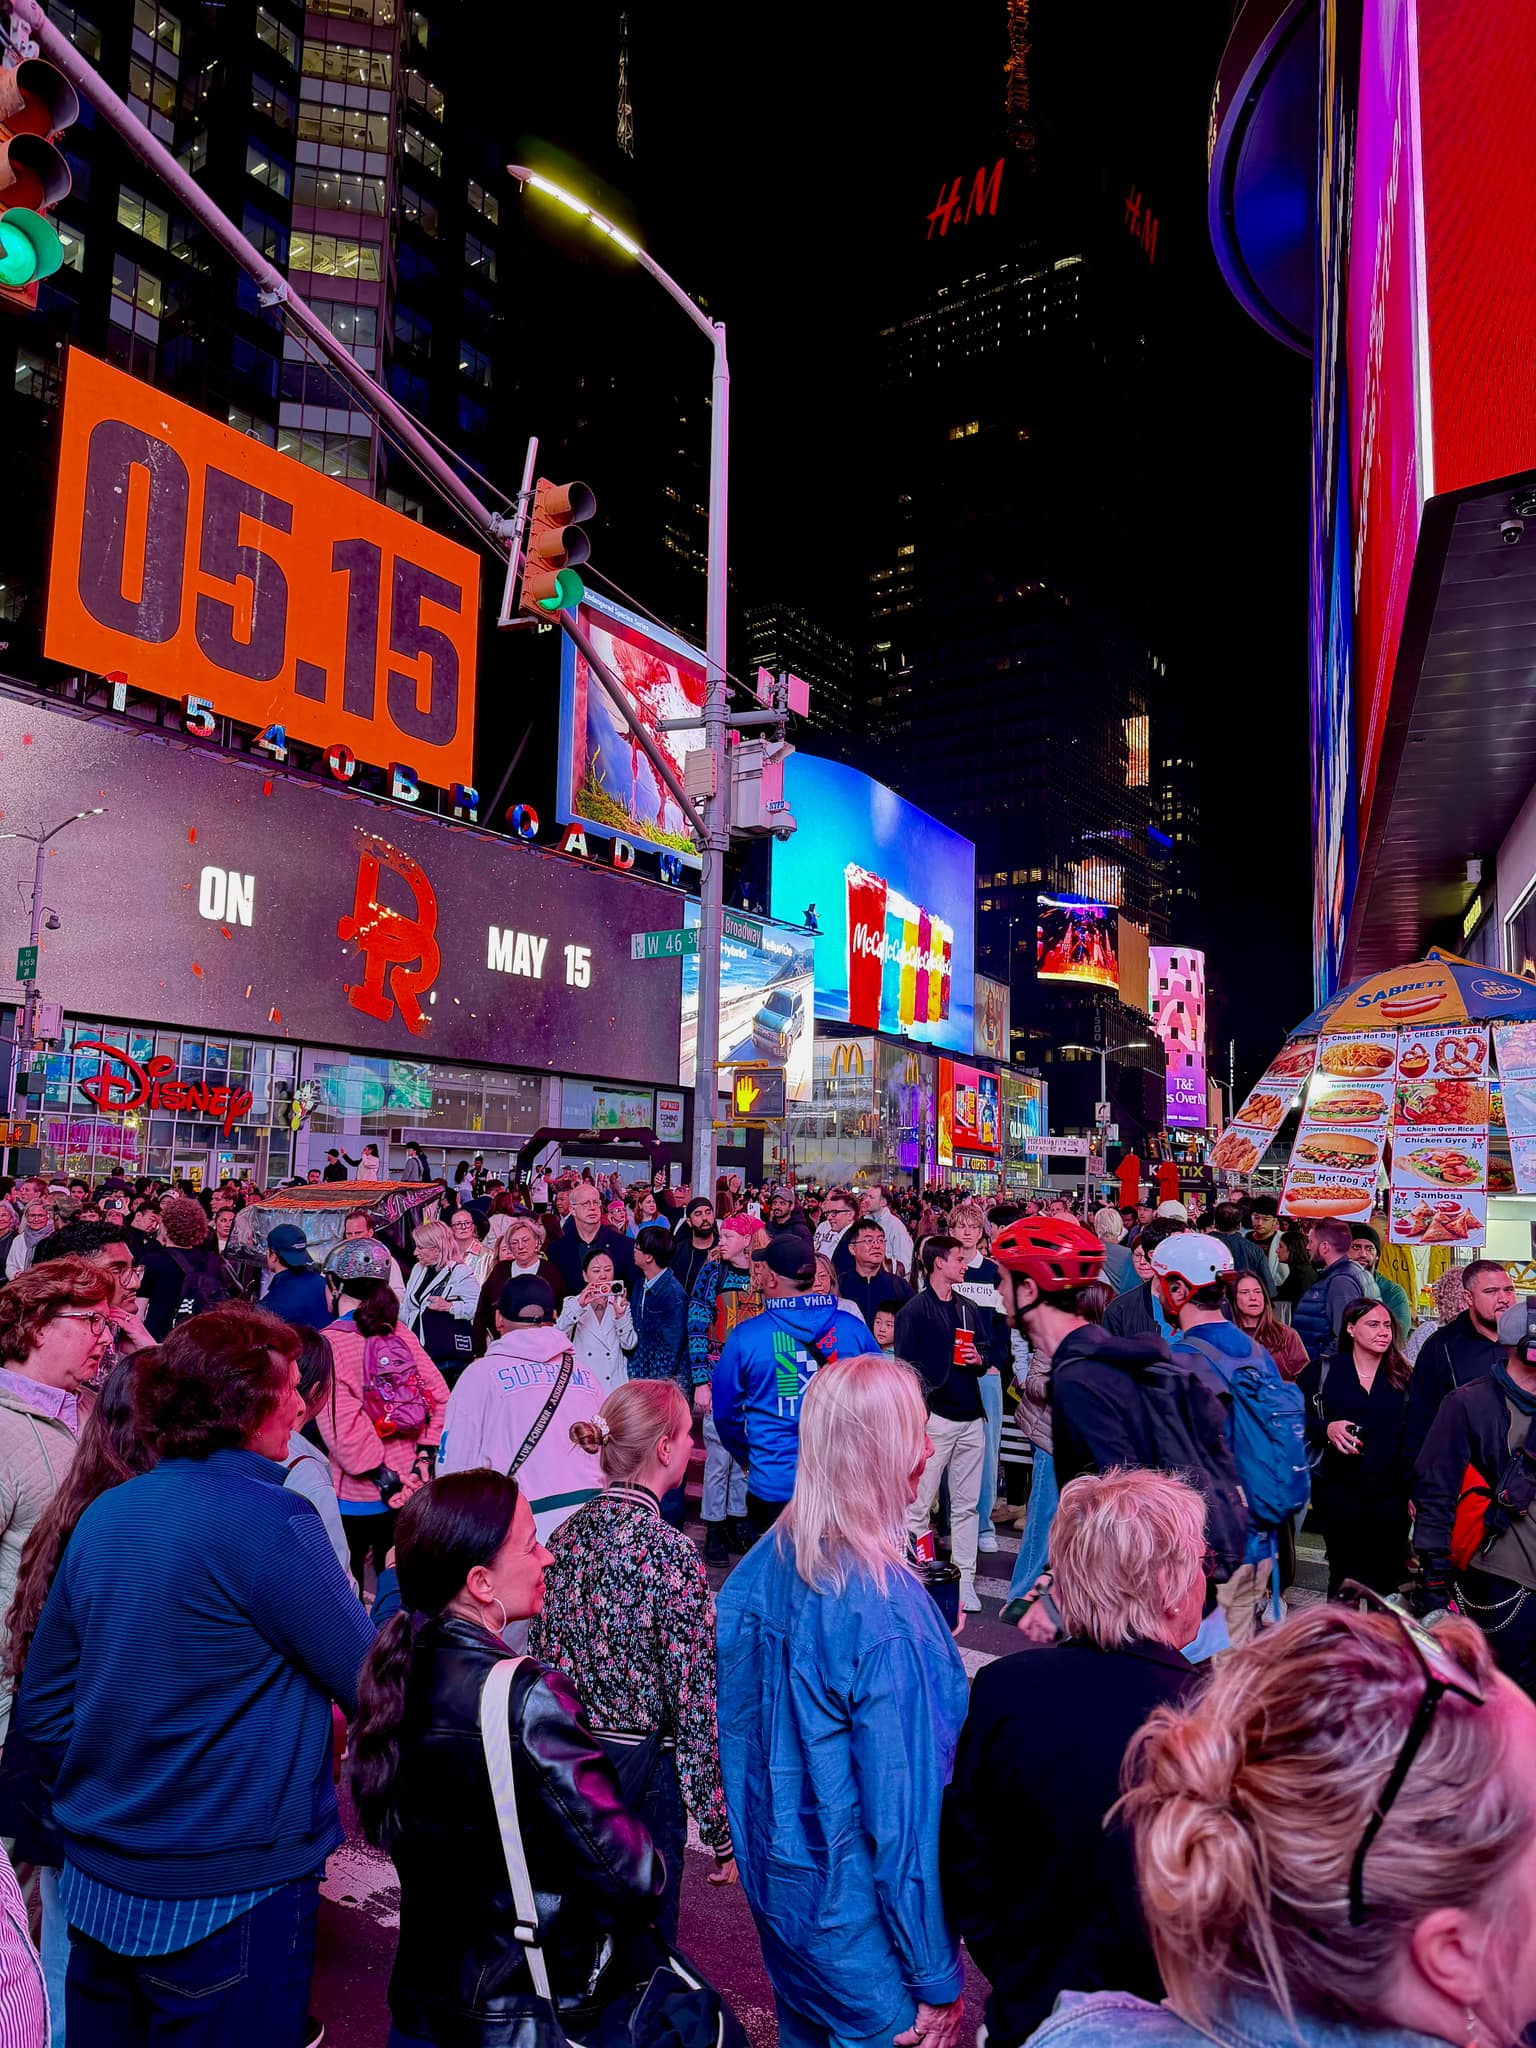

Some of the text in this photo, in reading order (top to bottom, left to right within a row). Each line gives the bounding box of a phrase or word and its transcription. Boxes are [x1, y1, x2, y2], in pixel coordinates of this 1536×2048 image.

[926, 157, 1005, 240] H&M
[1124, 185, 1158, 264] H&M
[78, 419, 463, 746] 05.15
[199, 866, 255, 927] ON
[487, 926, 548, 979] MAY
[564, 944, 591, 988] 15
[725, 916, 761, 947] Broadway
[647, 932, 699, 954] W 46 St
[1355, 979, 1446, 1008] SABRETT
[1331, 1034, 1361, 1042] Cheese
[1380, 1032, 1396, 1040] Dog
[1414, 1027, 1482, 1039] CHEESE PRETZEL
[1174, 1078, 1195, 1091] T&E
[1175, 1091, 1198, 1104] Over
[660, 1113, 678, 1122] COMING
[1009, 1120, 1022, 1139] OLD
[1443, 1137, 1468, 1145] Gyro
[1318, 1174, 1337, 1182] Hot
[1340, 1175, 1359, 1185] Dog
[1413, 1191, 1463, 1200] Sambosa
[957, 1284, 993, 1296] York City
[767, 1295, 833, 1309] PUMA PUMA
[517, 1441, 532, 1462] LIVE
[528, 1409, 552, 1444] FOREVER
